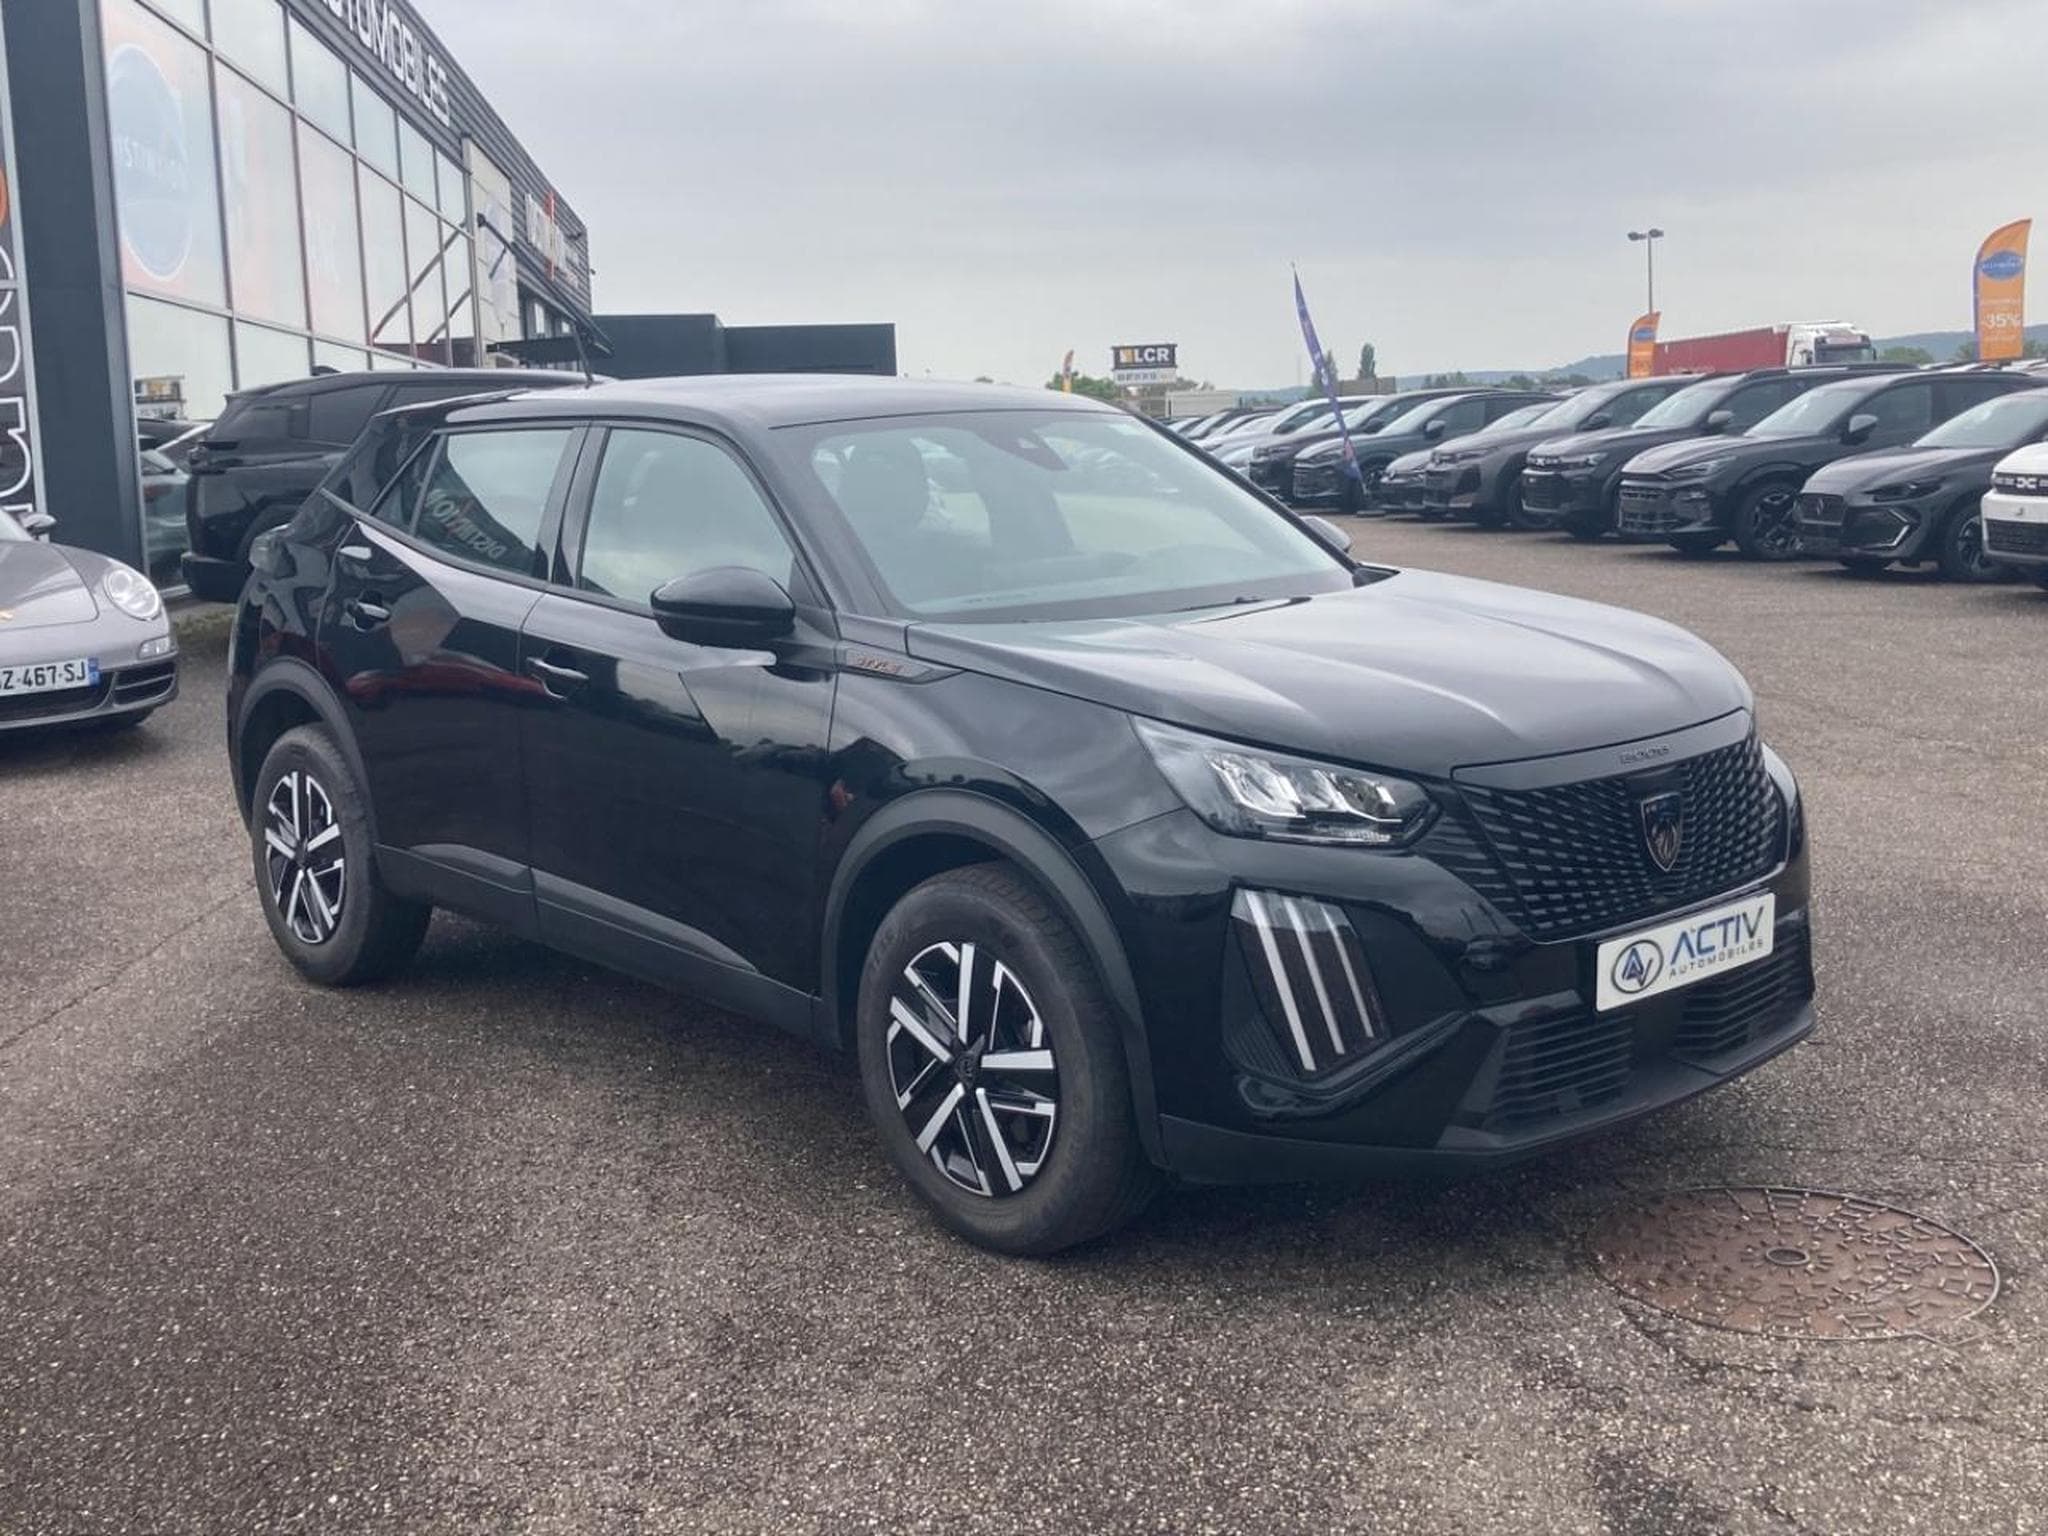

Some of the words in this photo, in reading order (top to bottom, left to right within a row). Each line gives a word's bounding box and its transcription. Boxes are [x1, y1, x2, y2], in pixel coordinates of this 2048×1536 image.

[322, 0, 449, 127] OMOBILES
[1134, 347, 1169, 363] LCR
[0, 661, 86, 690] Z-467-SJ
[1670, 906, 1765, 966] ACTIV
[1669, 937, 1764, 981] AUTOMOBILES
